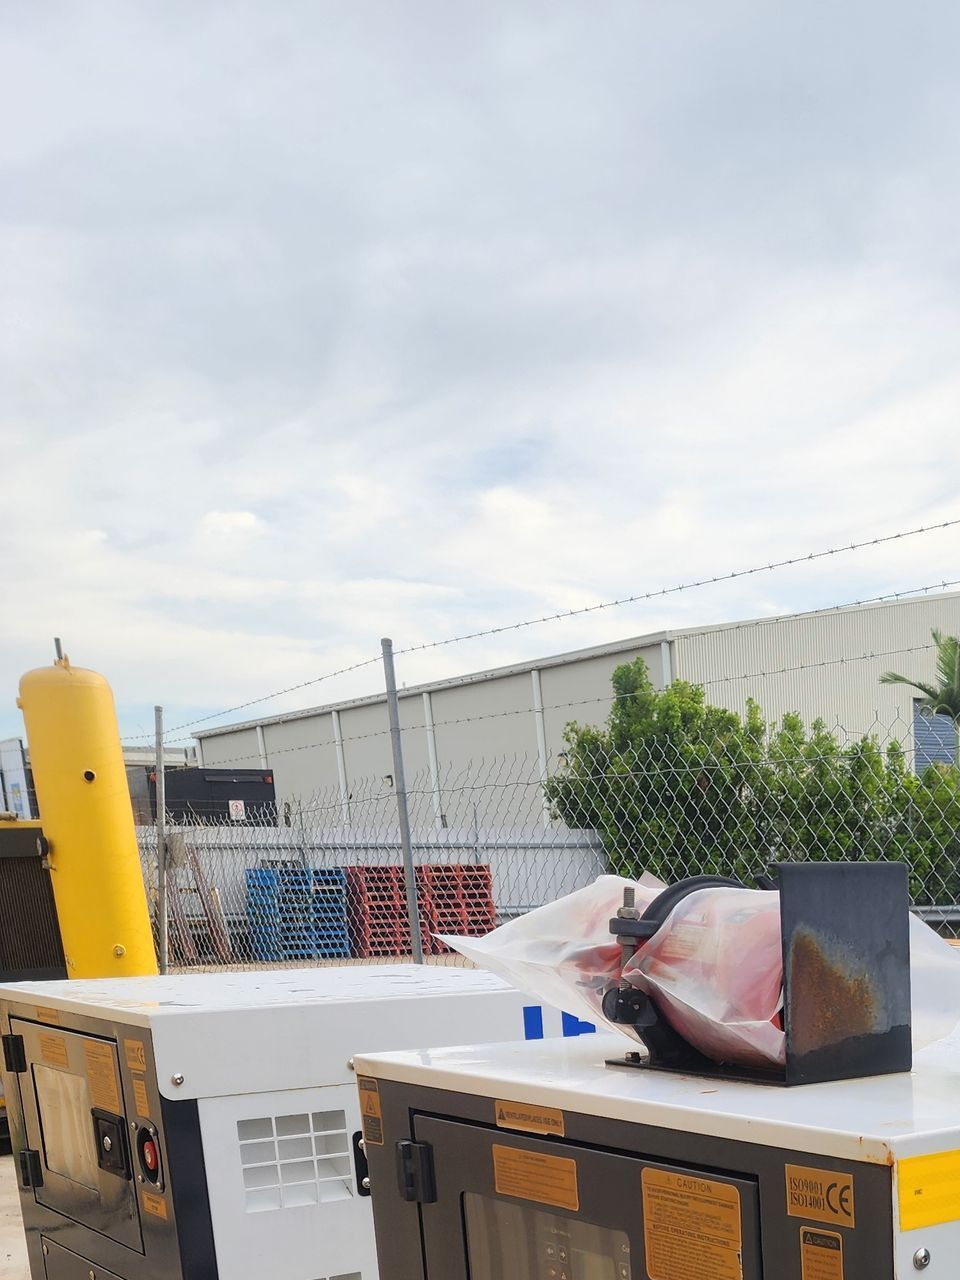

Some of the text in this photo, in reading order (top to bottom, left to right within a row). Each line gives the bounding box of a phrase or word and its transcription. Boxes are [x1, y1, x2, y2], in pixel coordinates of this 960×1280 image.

[677, 1177, 712, 1194] CAUTION
[790, 1177, 823, 1196] ISO9001
[790, 1192, 825, 1211] ISO14001
[826, 1183, 851, 1216] CE
